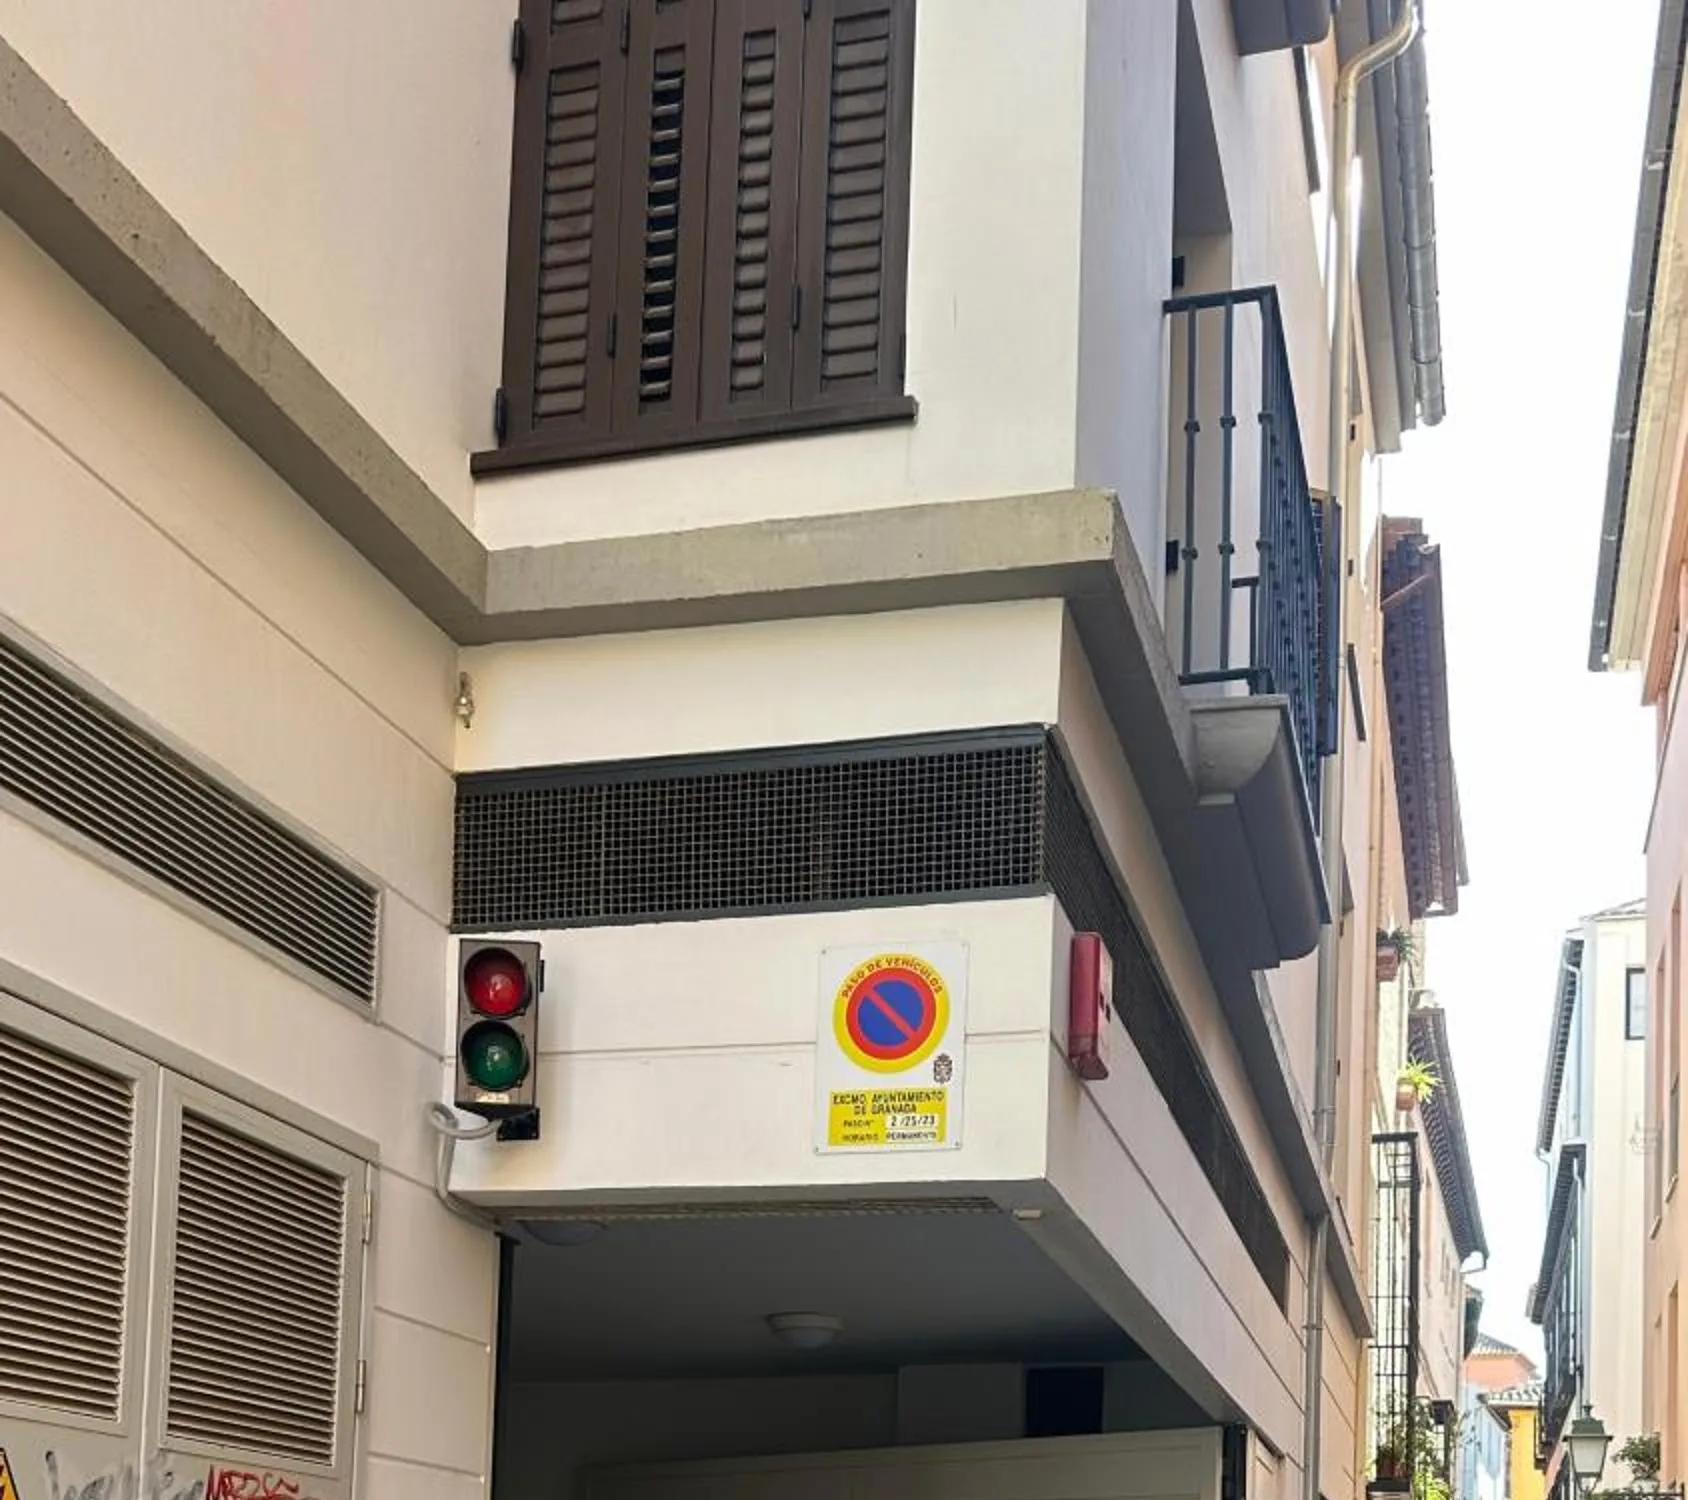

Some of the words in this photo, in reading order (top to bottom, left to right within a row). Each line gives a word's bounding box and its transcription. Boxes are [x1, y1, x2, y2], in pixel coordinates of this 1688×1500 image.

[841, 970, 865, 998] PASO
[866, 958, 882, 972] DE
[871, 1090, 945, 1103] AYUNTAMIENTO
[853, 1105, 867, 1116] DE
[871, 1103, 917, 1115] GRANADA
